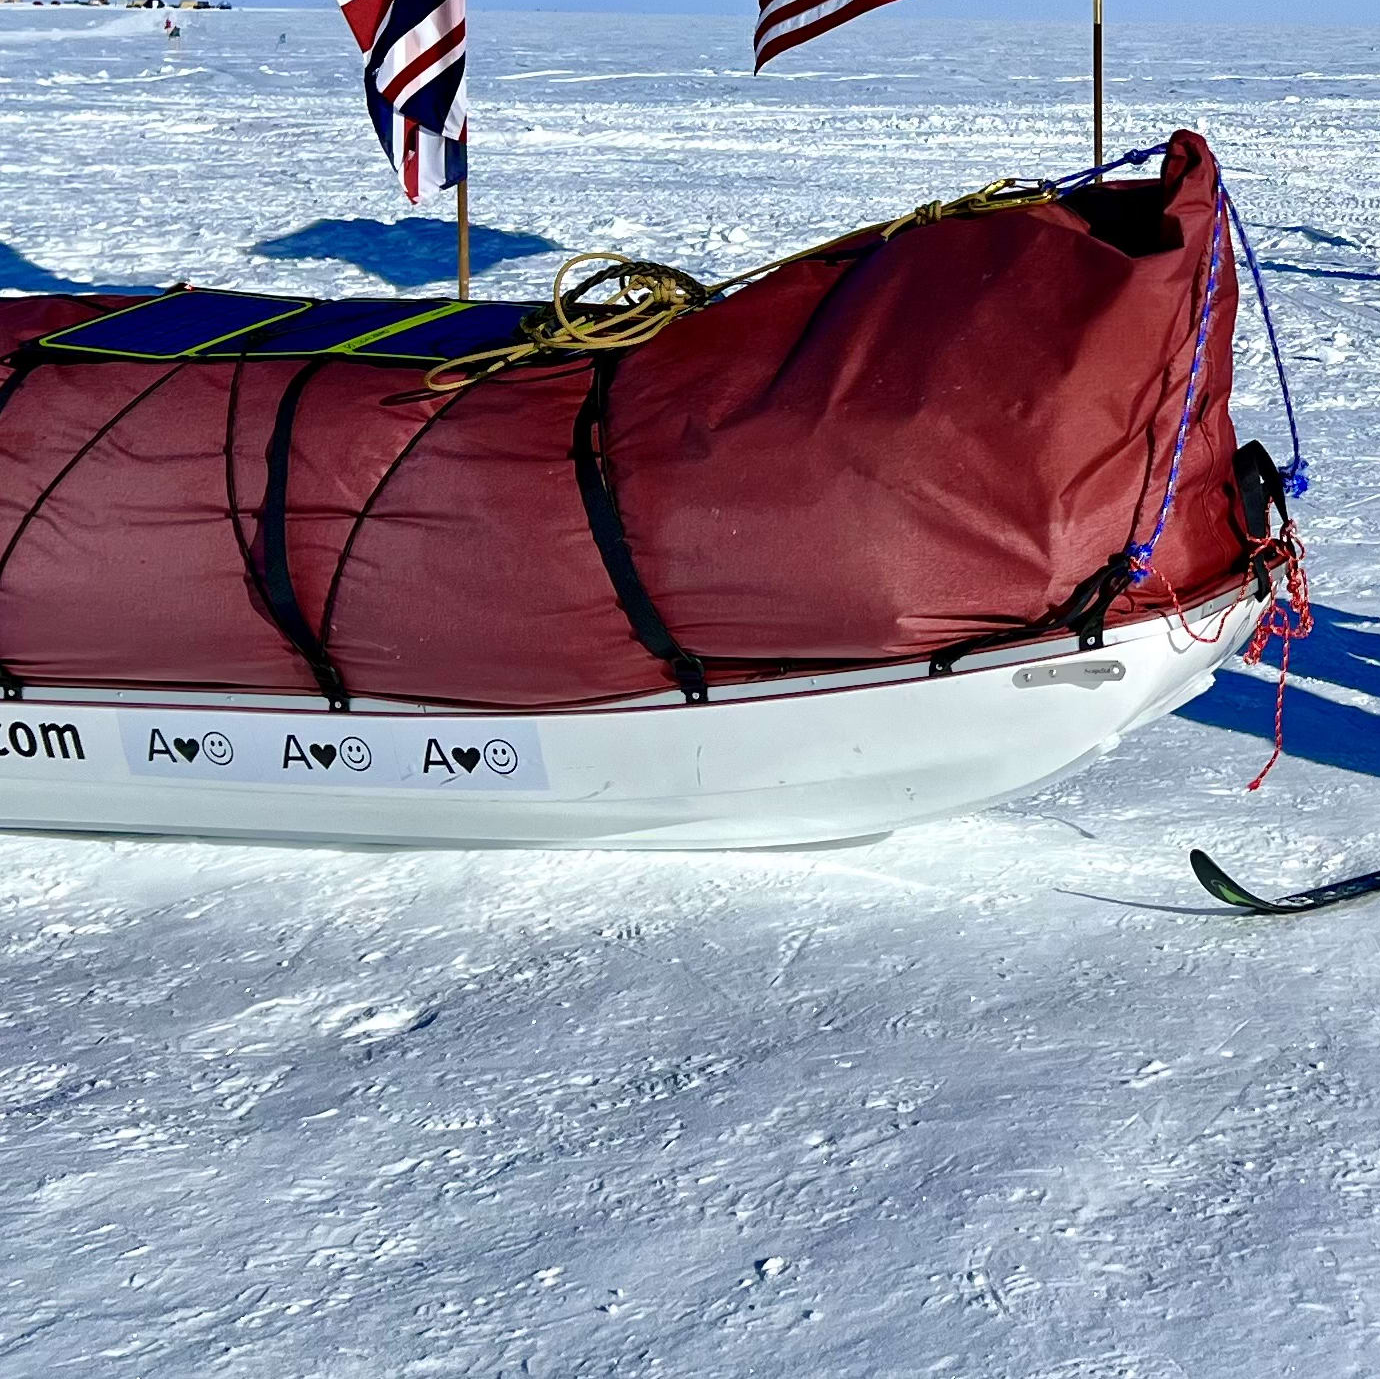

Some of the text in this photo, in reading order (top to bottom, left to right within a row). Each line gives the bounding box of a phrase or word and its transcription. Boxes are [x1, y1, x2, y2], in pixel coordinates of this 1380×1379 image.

[148, 728, 455, 773] A A A
